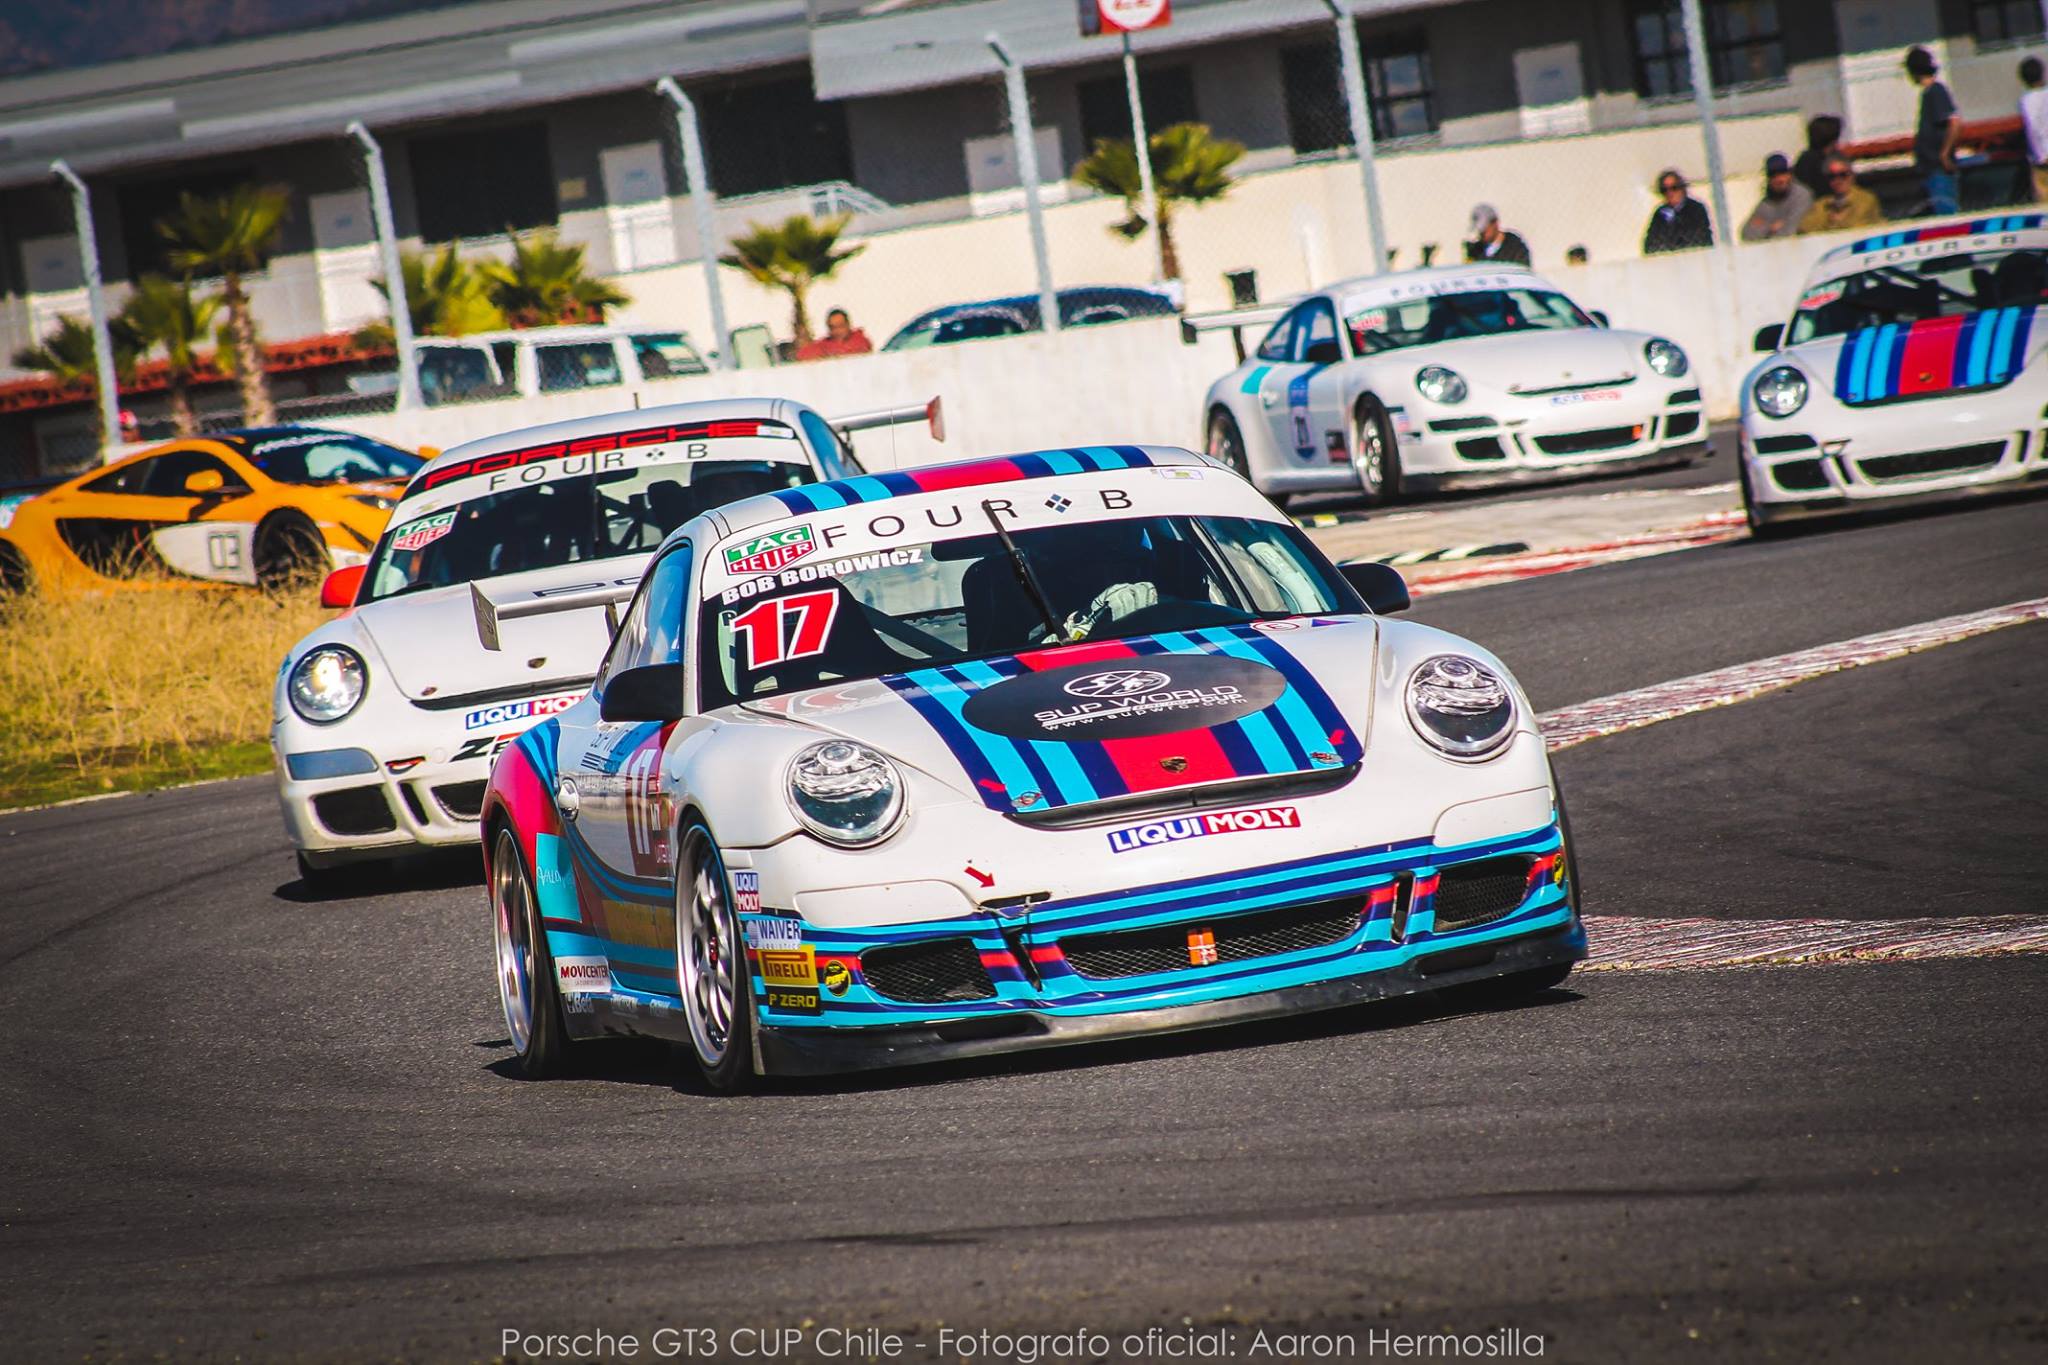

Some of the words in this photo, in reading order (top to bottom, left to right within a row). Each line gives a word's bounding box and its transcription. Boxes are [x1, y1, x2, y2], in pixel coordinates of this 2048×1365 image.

[425, 422, 763, 490] PORSCHE
[490, 451, 625, 491] FOUR
[687, 443, 709, 459] B
[400, 515, 453, 534] TAG
[821, 498, 1018, 548] FOUR
[1099, 489, 1132, 510] B
[393, 525, 451, 548] HEUER
[730, 526, 811, 559] TAG
[730, 541, 812, 572] HEUER
[722, 575, 777, 606] BOB
[780, 547, 924, 587] BOROWICZ
[729, 588, 839, 671] 17
[468, 703, 529, 726] LIQUI
[533, 696, 585, 715] MO
[1034, 702, 1103, 722] SUP
[1108, 685, 1239, 707] WORLD
[1110, 817, 1203, 851] LIQUI
[1208, 808, 1295, 835] MOLY
[735, 873, 758, 892] LIQUI
[737, 893, 760, 911] MOLY
[758, 919, 800, 940] WAIVER
[761, 951, 811, 979] PIRELLI
[769, 993, 777, 1006] P
[780, 994, 817, 1008] ZERO
